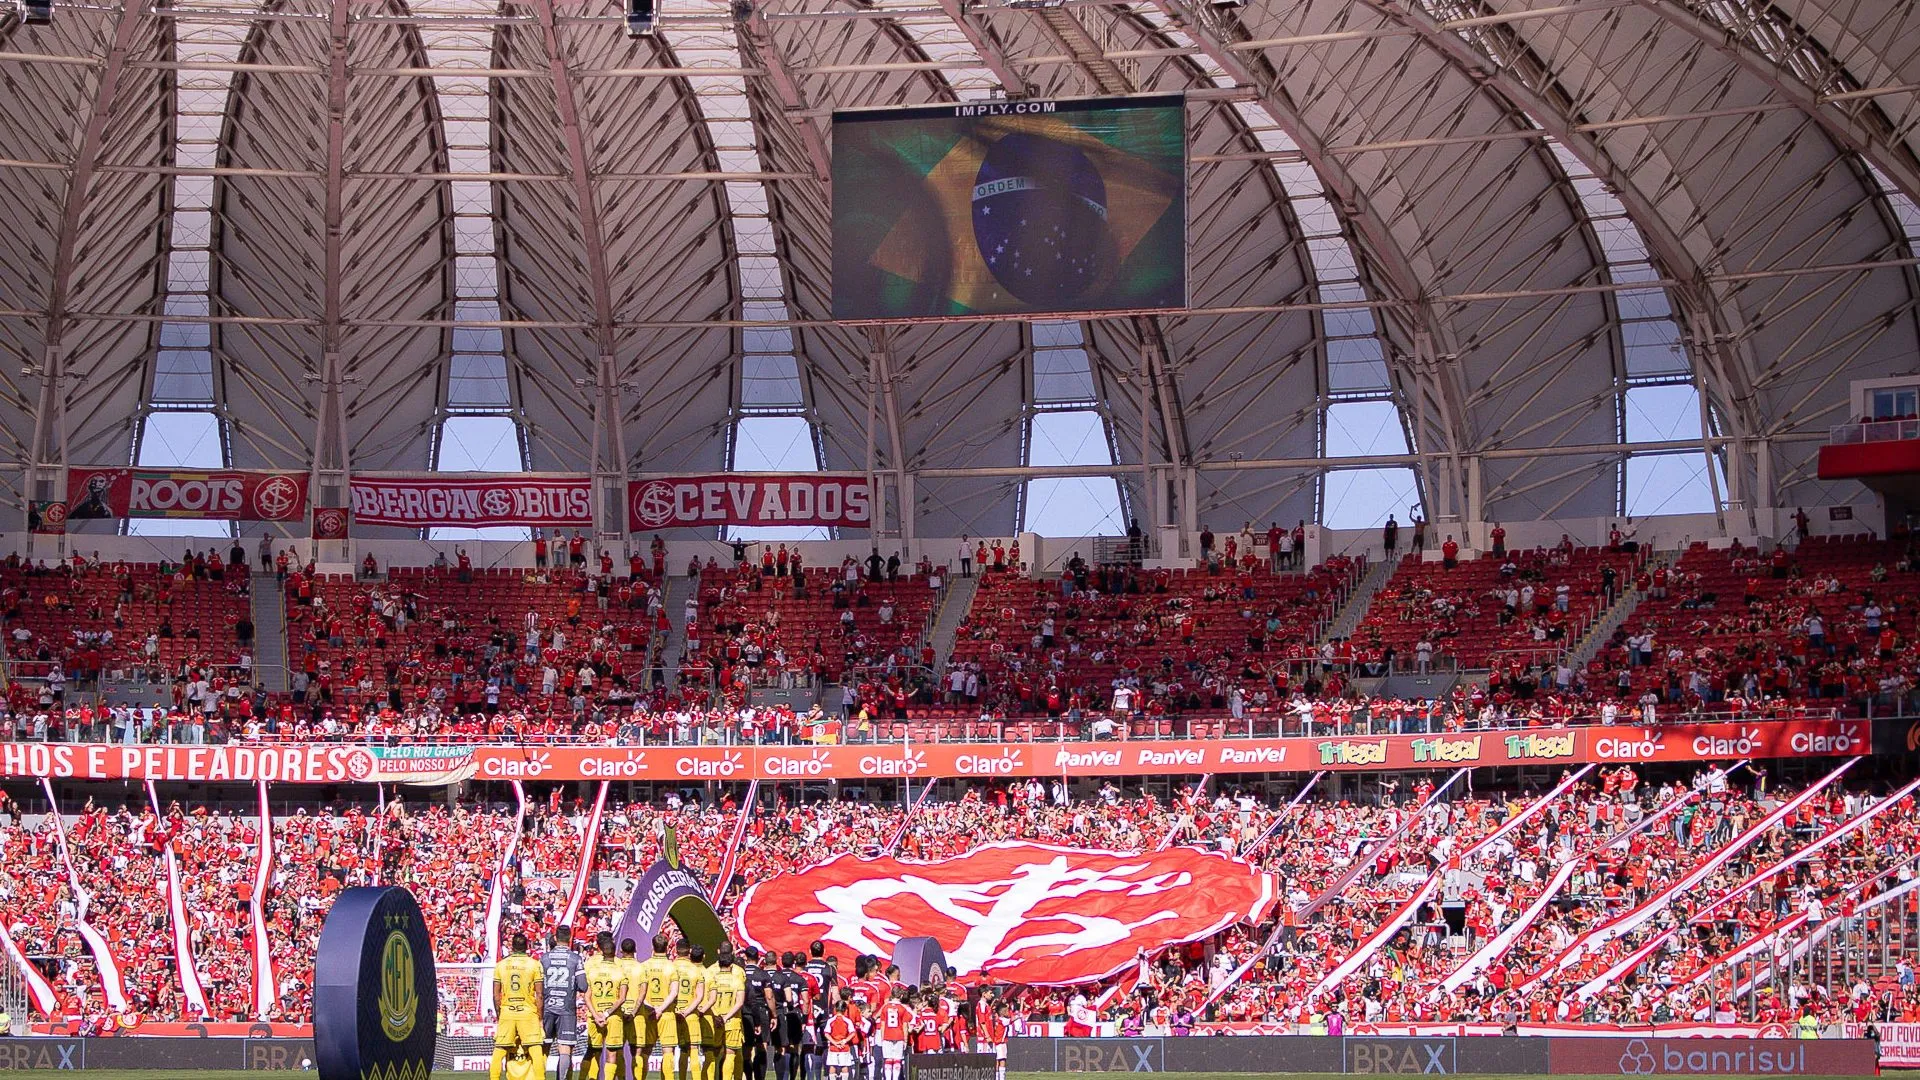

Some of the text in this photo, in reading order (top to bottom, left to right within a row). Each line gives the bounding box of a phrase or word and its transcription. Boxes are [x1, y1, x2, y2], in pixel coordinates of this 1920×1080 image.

[955, 102, 1056, 117] IMPLY.COM
[977, 179, 1025, 197] ORDEM
[128, 479, 244, 510] ROOTS
[357, 486, 590, 519] BERGA BUS
[674, 482, 870, 521] CEVADOS
[383, 746, 411, 758] PELO
[413, 746, 433, 758] RIO
[1317, 739, 1388, 765] Trilegal
[1410, 735, 1483, 763] Trilegal
[1504, 731, 1576, 759] Trilegal
[1595, 737, 1655, 758] Claro
[1692, 733, 1752, 755] Claro
[1790, 730, 1850, 753] Claro
[4, 744, 349, 781] HOS E PELEADORES
[380, 759, 406, 772] PELO
[409, 758, 445, 771] NOSSO
[483, 755, 542, 776] Claro
[579, 755, 639, 776] Claro
[675, 755, 736, 776] Claro
[764, 754, 822, 775] Claro
[859, 754, 918, 775] Claro
[955, 753, 1014, 774] Claro
[510, 974, 521, 991] 6
[547, 966, 569, 988] 22
[651, 977, 661, 994] 3
[681, 979, 690, 995] 9
[593, 980, 614, 998] 32
[887, 1008, 899, 1028] 8
[253, 1045, 312, 1071] BRA
[1065, 1044, 1154, 1073] BRAX
[1353, 1044, 1447, 1074] BRAX
[1663, 1044, 1805, 1072] banrisul
